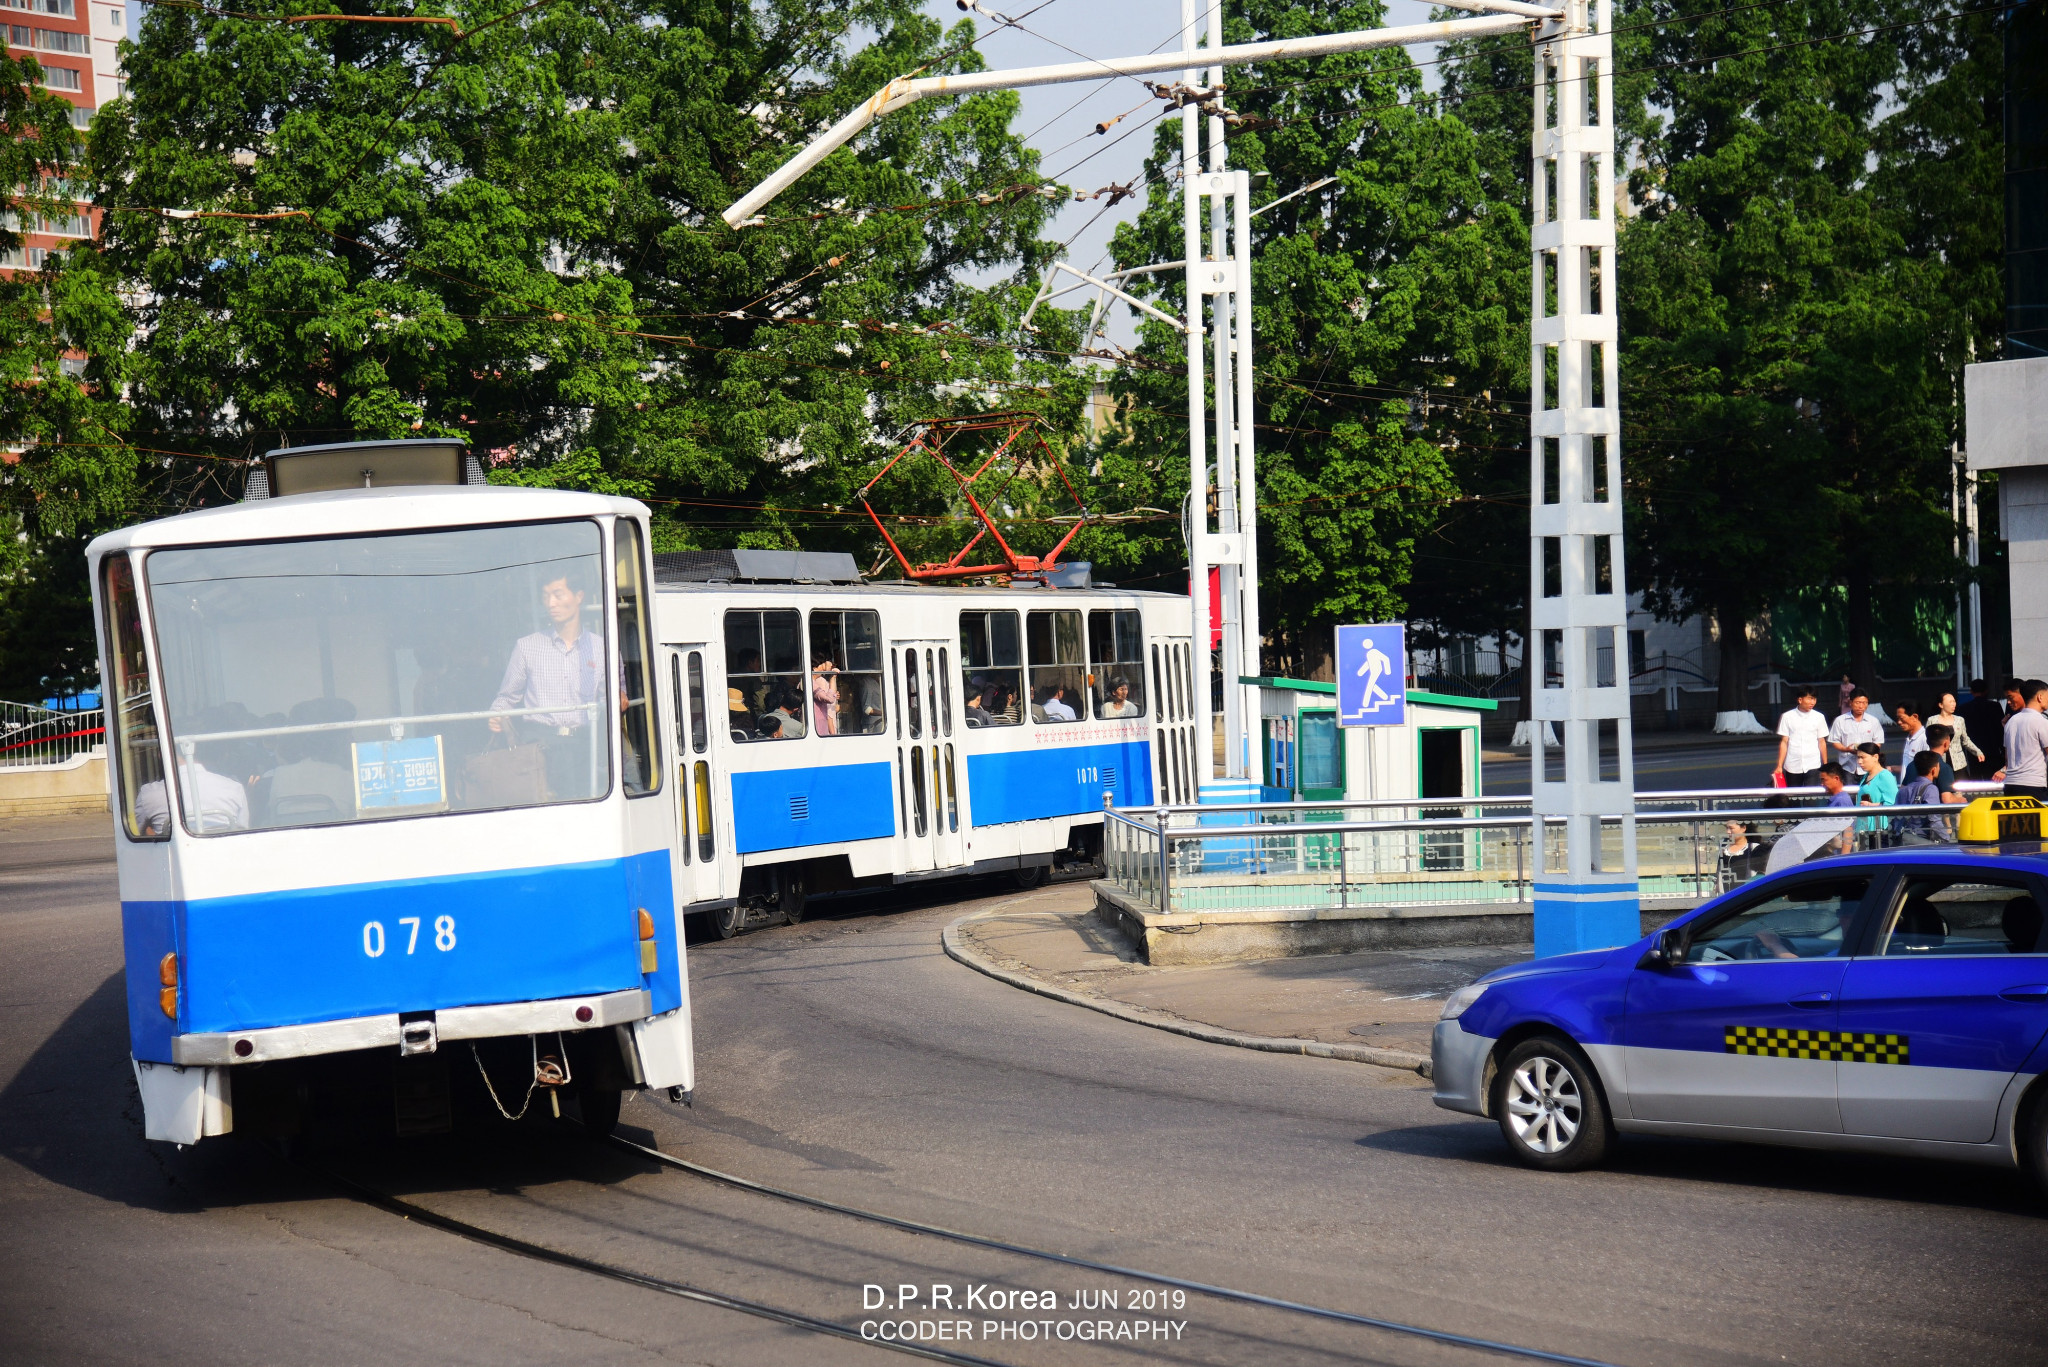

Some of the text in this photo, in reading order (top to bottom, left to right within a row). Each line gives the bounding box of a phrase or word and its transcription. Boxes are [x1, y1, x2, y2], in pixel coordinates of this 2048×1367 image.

[403, 761, 438, 789] 평양역
[1077, 766, 1098, 784] 1078
[1997, 799, 2035, 809] TAXI
[1999, 815, 2037, 835] TAXI
[363, 915, 457, 958] 078
